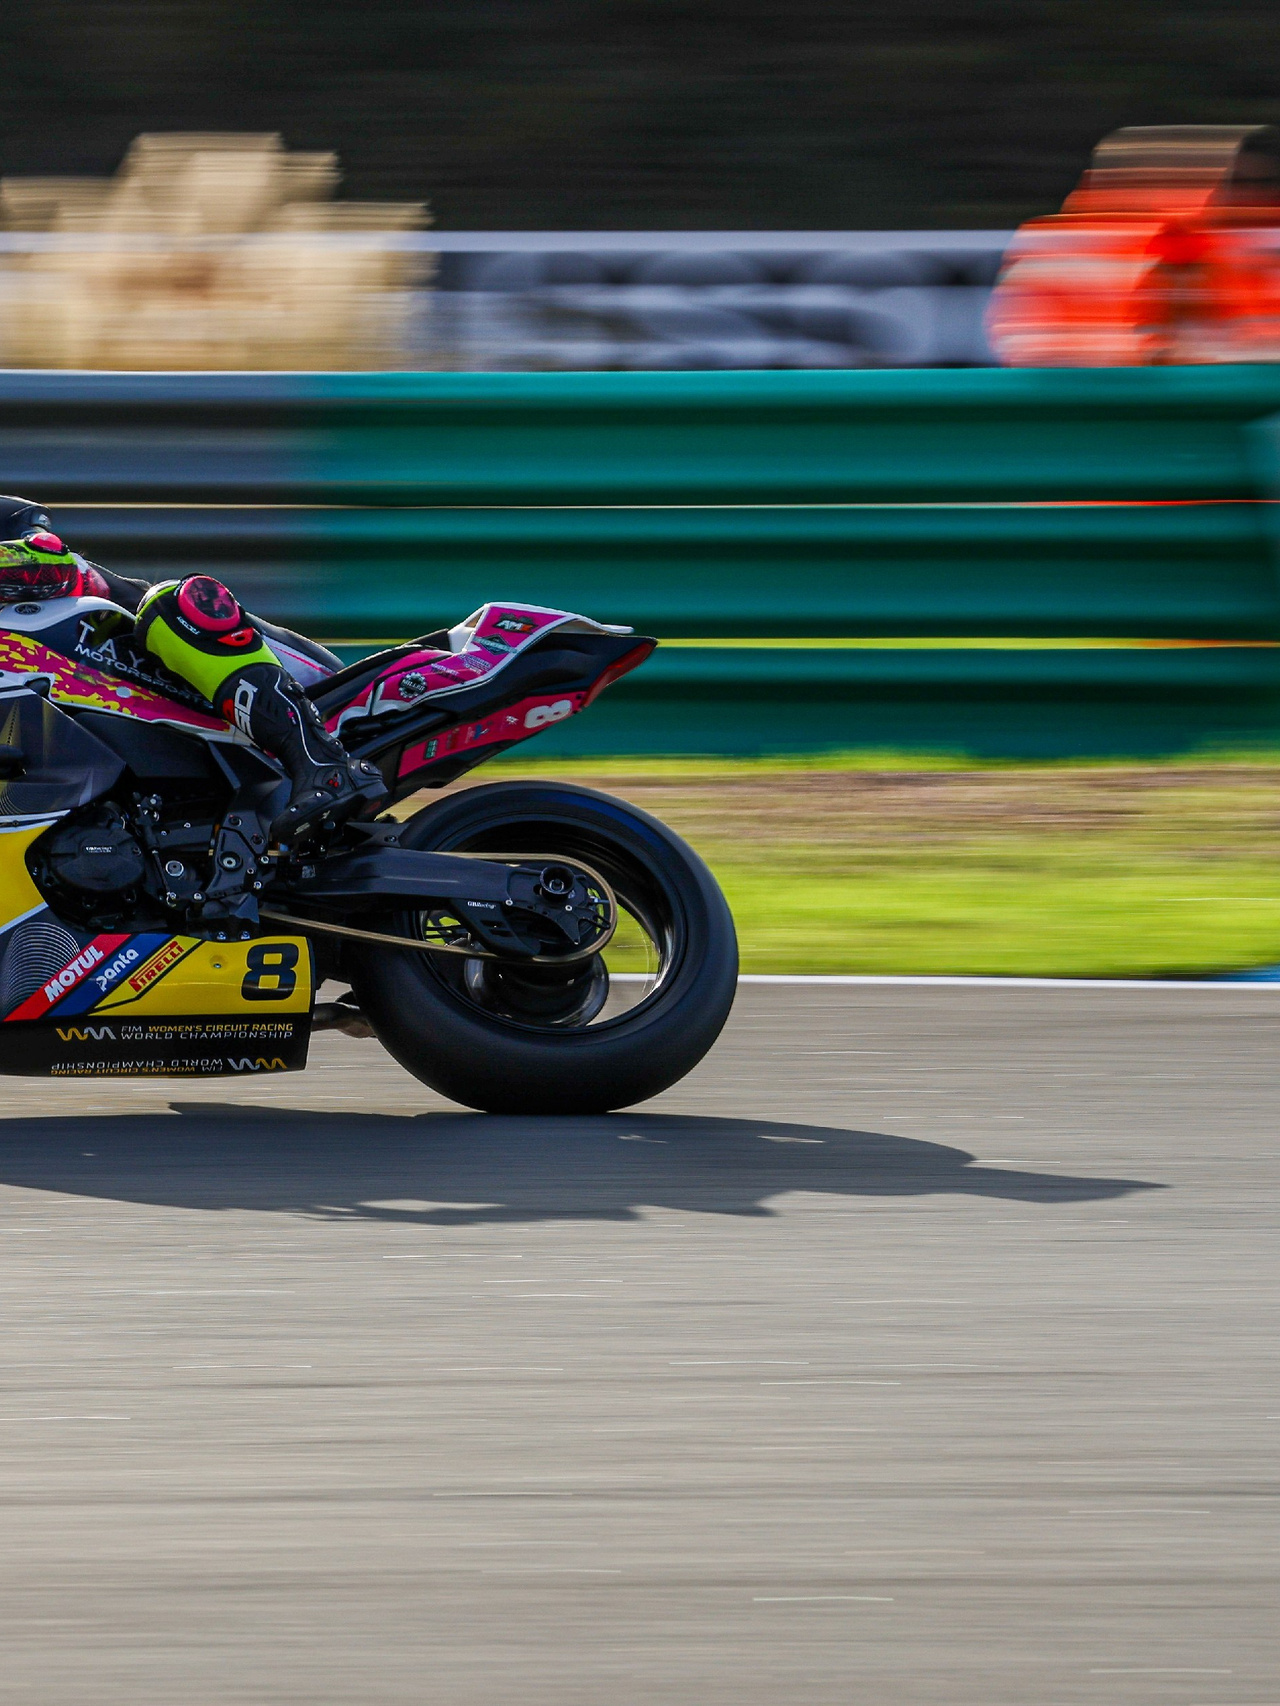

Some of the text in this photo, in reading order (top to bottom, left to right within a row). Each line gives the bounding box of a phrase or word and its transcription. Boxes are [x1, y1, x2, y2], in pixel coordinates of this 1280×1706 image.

[524, 699, 573, 729] 8
[43, 945, 105, 1003] MOTUL
[128, 941, 185, 993] PIRELLI
[241, 943, 300, 1001] 8
[120, 1031, 293, 1040] WORLD CHAMPIONSHIP
[121, 1023, 293, 1033] FIM WOMEN'S CIRCUIT RACING
[52, 1058, 223, 1070] WORLD CHAMPIONSHIP
